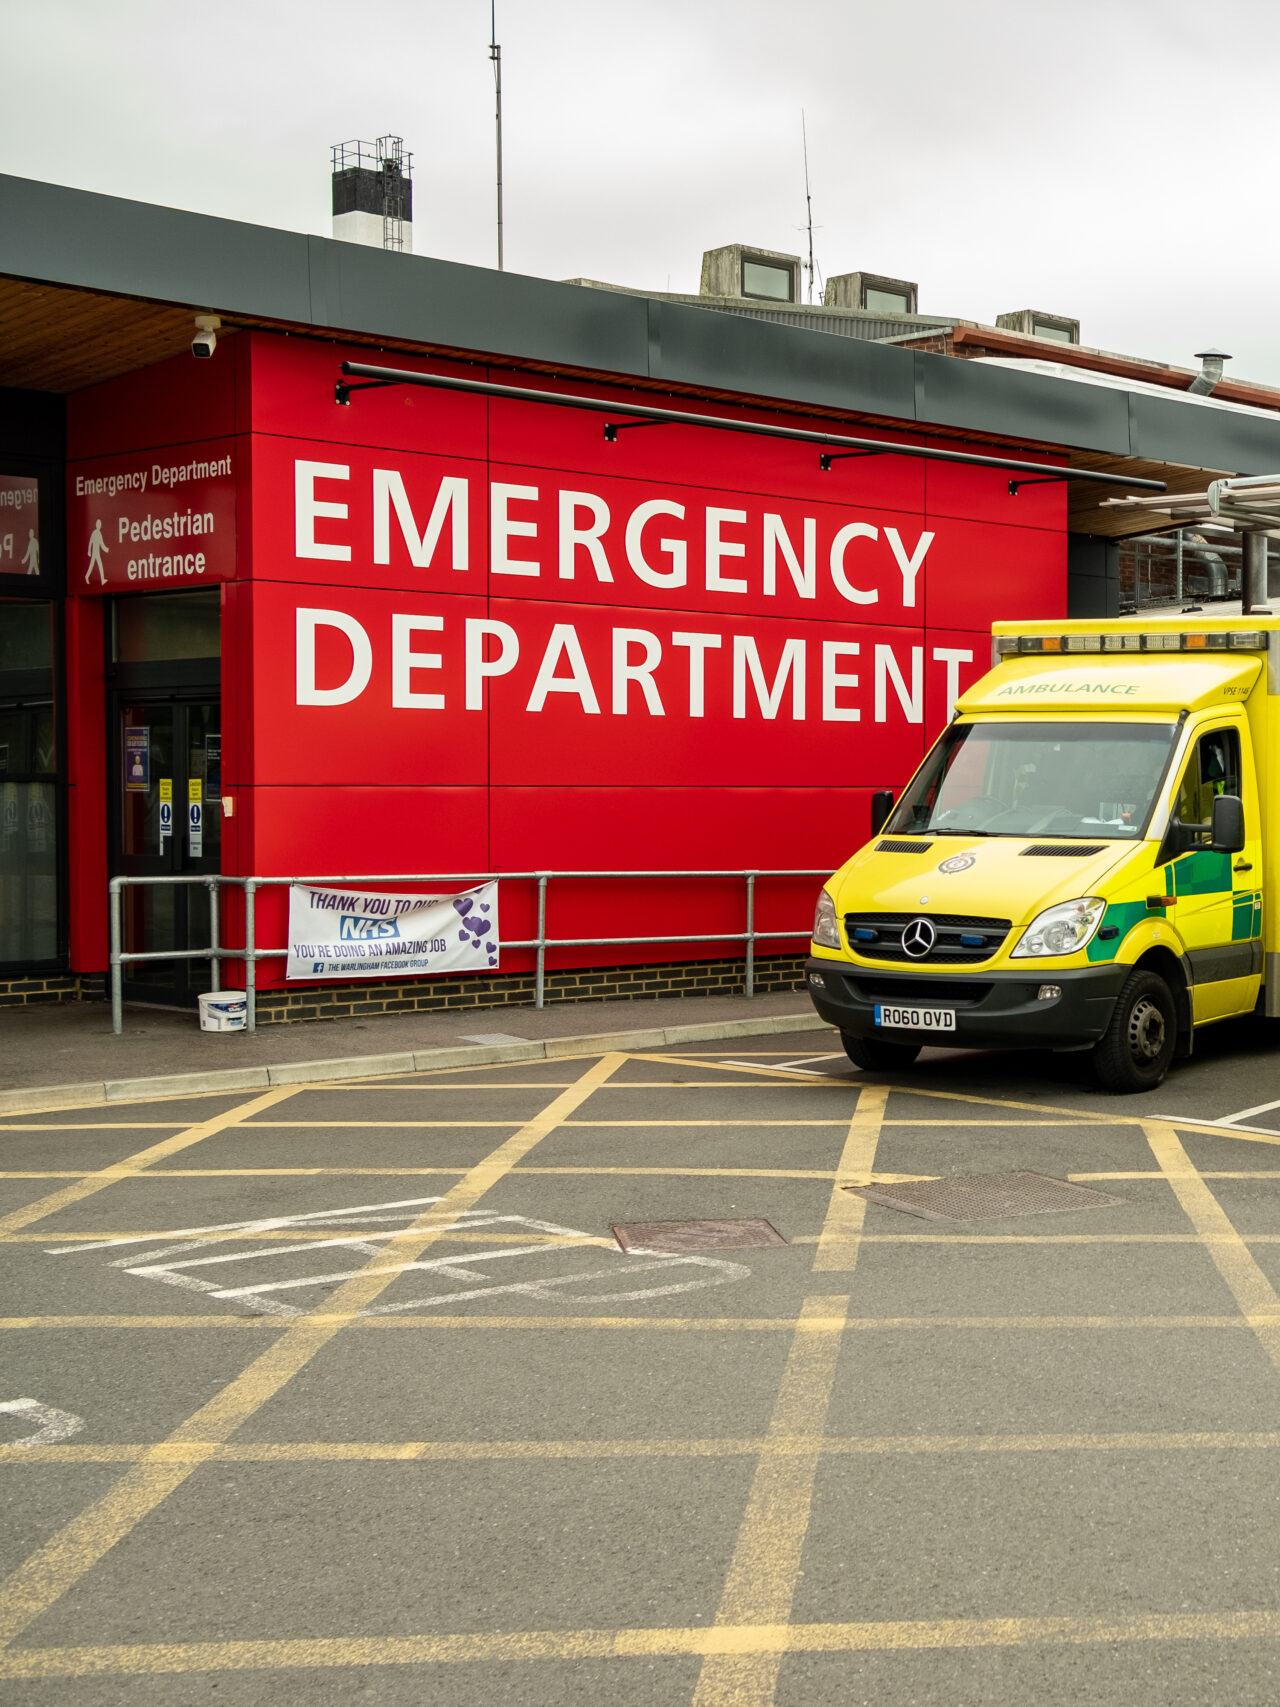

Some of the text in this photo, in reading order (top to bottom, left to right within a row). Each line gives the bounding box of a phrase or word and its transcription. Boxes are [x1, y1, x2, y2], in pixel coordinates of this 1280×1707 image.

[76, 455, 232, 497] Emergency Department
[118, 508, 214, 544] Pedestrian
[295, 459, 935, 608] EMERGENCY
[127, 552, 206, 580] entrance
[295, 607, 974, 725] DEPARTMENT
[997, 683, 1140, 696] AMBULANCE
[309, 891, 360, 912] THANK
[362, 898, 391, 916] YOU
[393, 899, 412, 916] TO
[341, 917, 397, 939] NHS
[294, 938, 447, 958] YOU'RE DOING AN AMAZING JOB
[327, 963, 340, 971] THE
[340, 961, 380, 971] WARLINGHAM
[380, 960, 409, 969] FACEBOOK
[409, 958, 429, 968] GROUP
[883, 1008, 953, 1028] RO60 OVD
